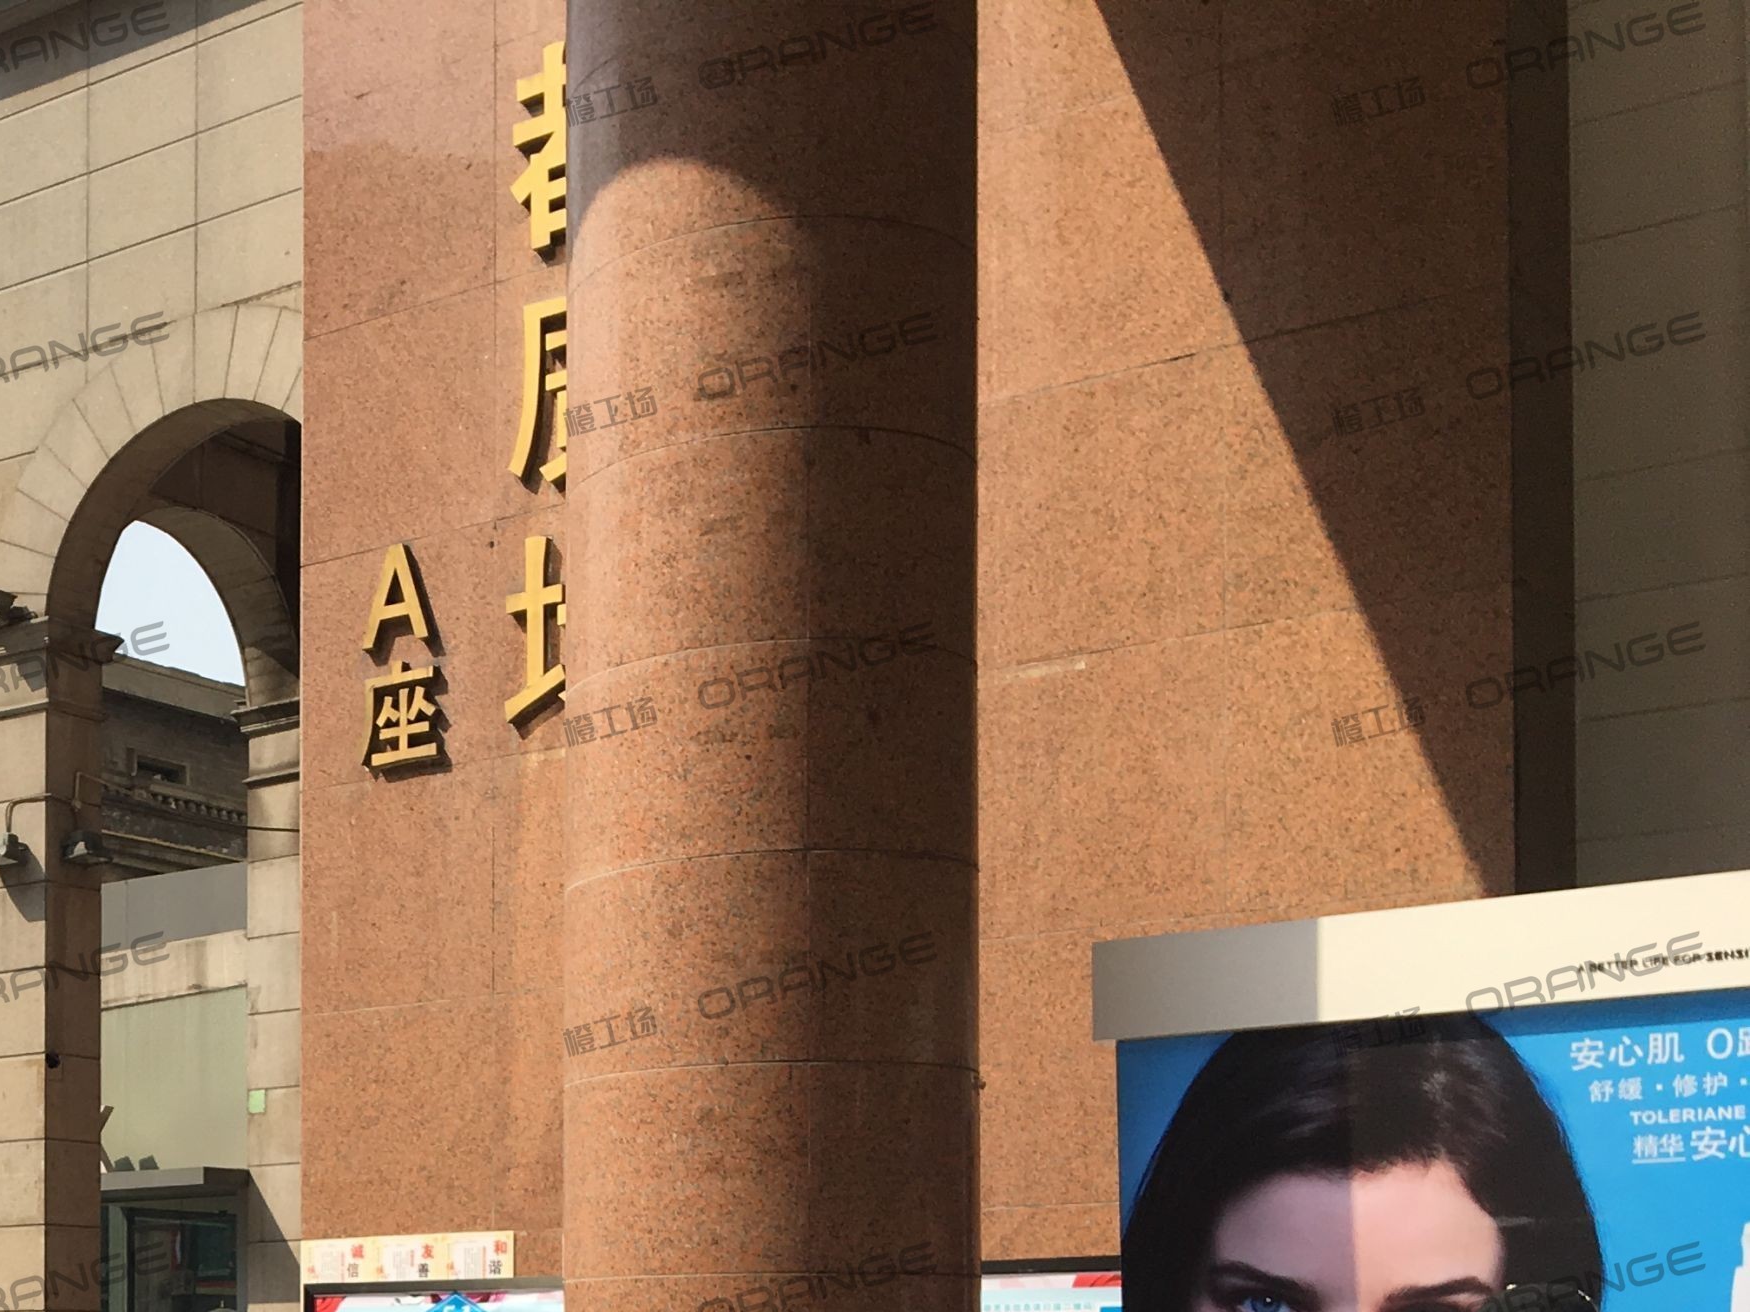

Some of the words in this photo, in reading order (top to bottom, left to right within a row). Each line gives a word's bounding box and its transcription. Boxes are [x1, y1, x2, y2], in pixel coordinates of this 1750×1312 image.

[361, 542, 439, 767] A座
[1570, 1035, 1685, 1071] 安心肌
[1630, 1104, 1746, 1125] TOLERIANE
